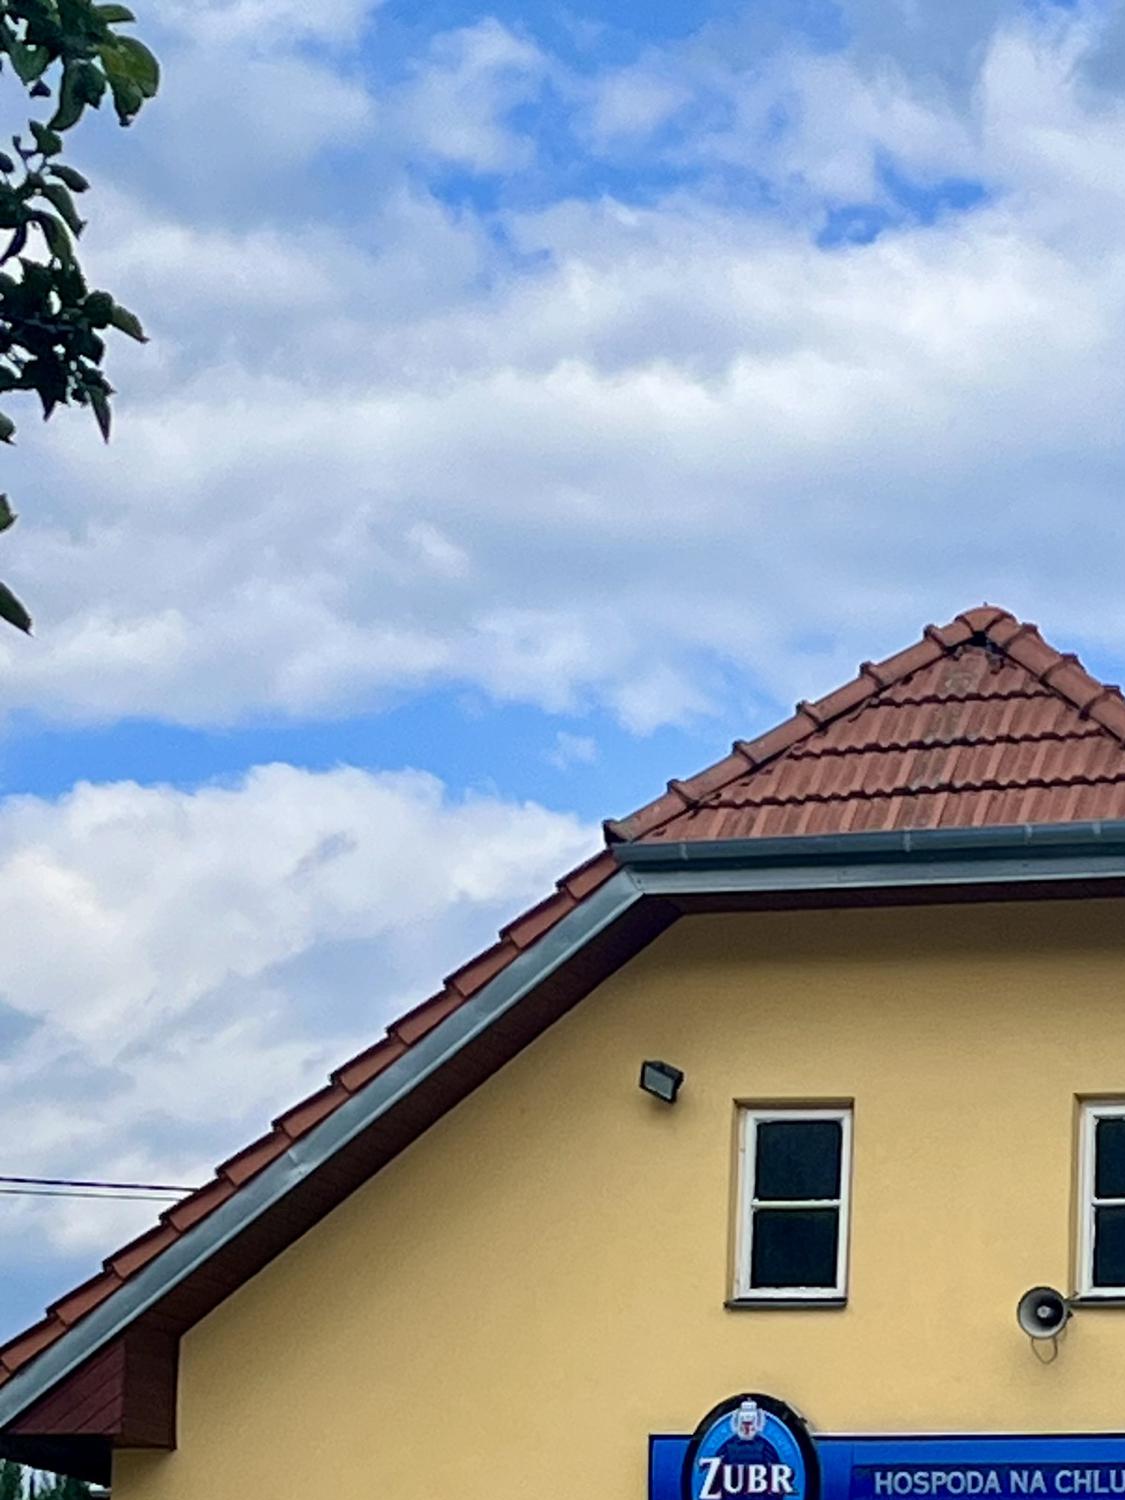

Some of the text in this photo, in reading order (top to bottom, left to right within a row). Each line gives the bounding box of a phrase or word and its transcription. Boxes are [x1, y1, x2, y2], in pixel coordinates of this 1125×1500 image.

[699, 1456, 796, 1500] ZUBR
[875, 1471, 1002, 1494] HOSPODA
[1010, 1470, 1048, 1493] NA
